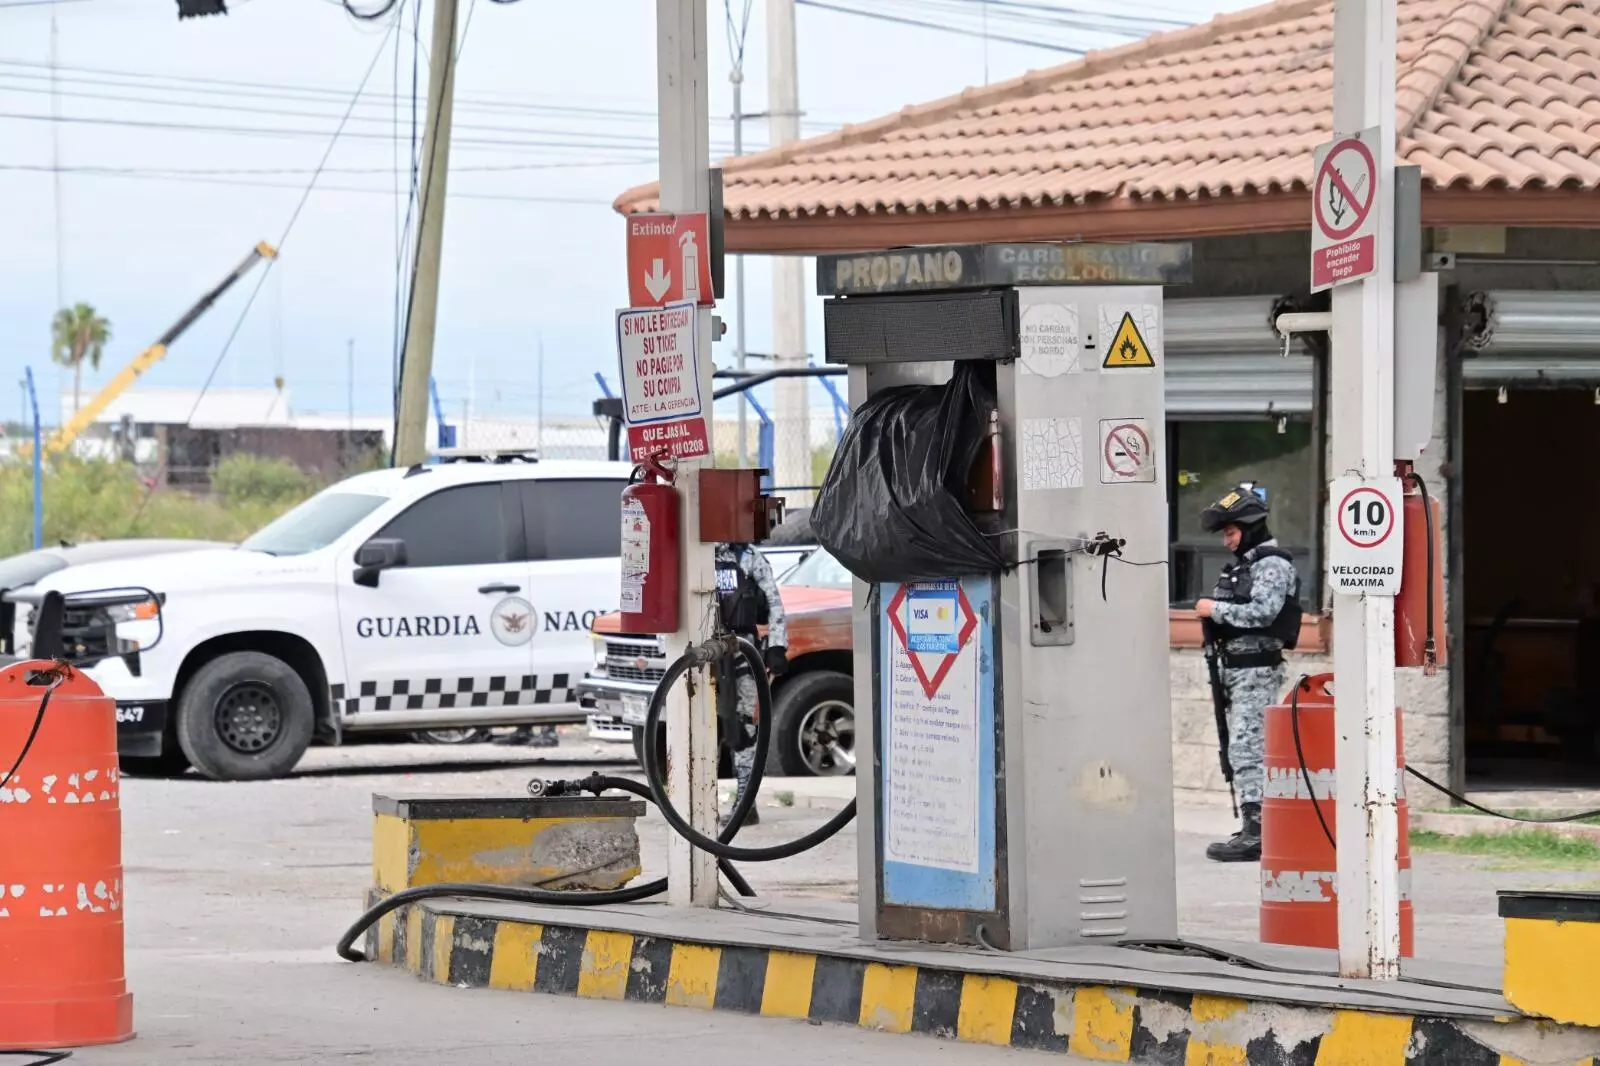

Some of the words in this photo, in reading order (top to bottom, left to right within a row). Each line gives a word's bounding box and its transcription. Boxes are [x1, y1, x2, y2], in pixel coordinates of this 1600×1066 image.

[632, 223, 676, 236] Extintor
[1001, 247, 1176, 264] CARBURACIO
[1326, 242, 1361, 258] Prohibido
[1326, 253, 1360, 269] encender
[836, 250, 963, 289] PROPANO
[1018, 265, 1160, 281] ECOLOGI
[1332, 265, 1353, 278] fuego
[624, 318, 632, 336] SI
[634, 317, 645, 334] NO
[648, 315, 658, 332] LE
[643, 337, 655, 355] SU
[656, 333, 677, 353] TICKET
[1037, 336, 1078, 345] PERSONAS
[636, 359, 648, 377] NO
[650, 355, 673, 375] PAGUE
[673, 354, 684, 372] POR
[643, 380, 655, 398] SU
[632, 403, 652, 414] ATTE:
[654, 402, 667, 411] LA
[667, 397, 696, 410] GERENCIA
[683, 439, 704, 453] 0208
[1347, 500, 1385, 526] 10
[1353, 528, 1376, 536] km/h
[1332, 566, 1394, 575] VELOCIDAD
[1340, 578, 1384, 587] MAXIMA
[913, 609, 929, 619] VISA
[356, 614, 481, 638] GUARDIA
[116, 706, 144, 722] 647
